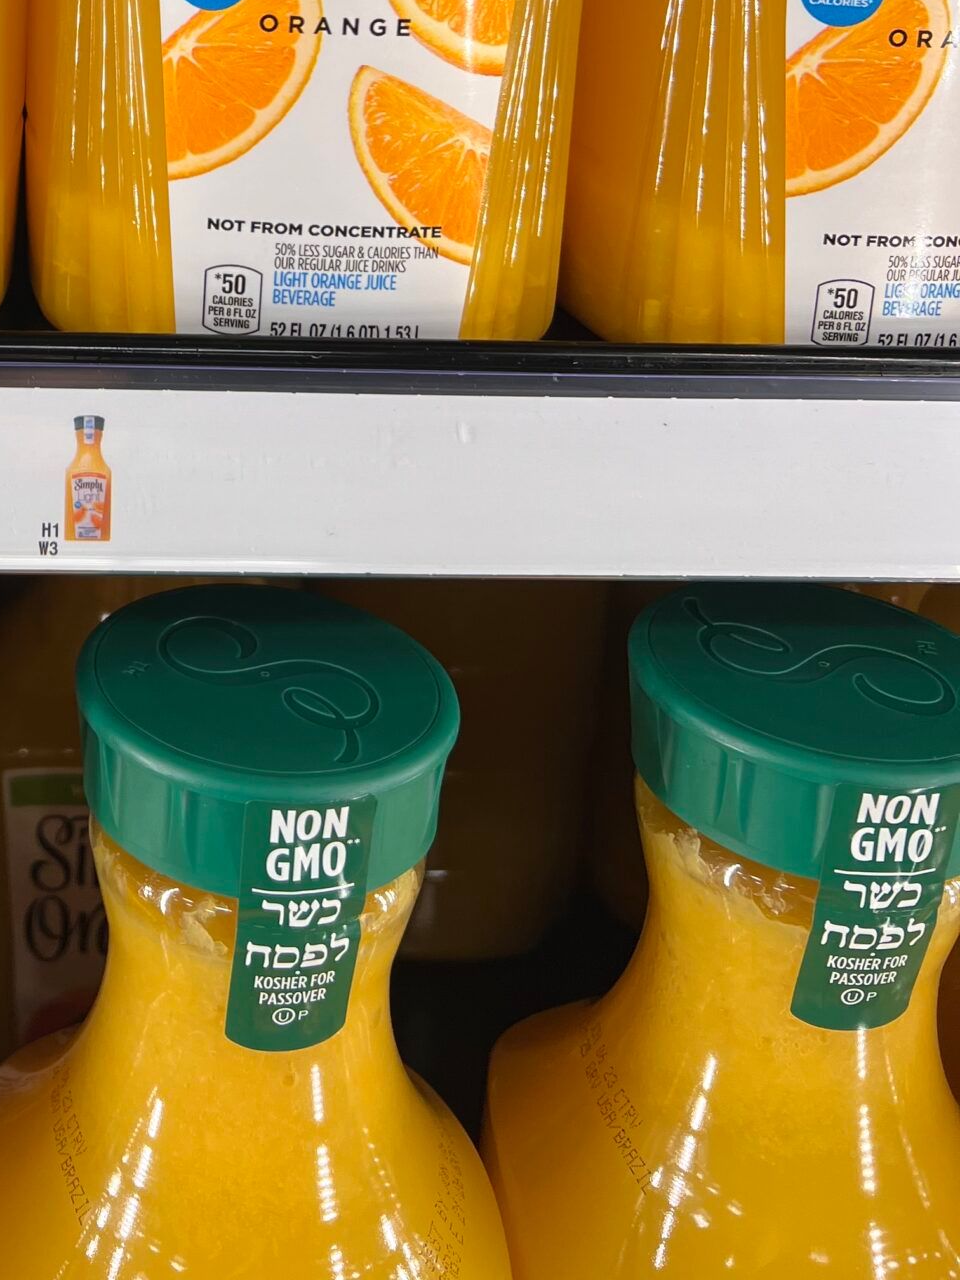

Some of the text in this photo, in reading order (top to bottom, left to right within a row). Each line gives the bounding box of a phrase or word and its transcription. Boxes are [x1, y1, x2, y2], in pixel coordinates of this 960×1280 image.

[258, 14, 412, 38] ORANGE
[207, 218, 442, 238] NOT FROM CONCENTRATE
[823, 234, 862, 247] NOT
[74, 478, 103, 493] Simply
[42, 523, 59, 538] H1
[38, 541, 58, 556] W3
[856, 793, 941, 825] NON
[269, 806, 350, 844] NON
[843, 880, 922, 910] כשר
[262, 898, 342, 928] כשר
[820, 918, 926, 950] לפסח
[245, 932, 350, 969] לפסח
[827, 954, 908, 970] KOSHER FOR
[254, 970, 335, 990] KOSHER FOR
[829, 971, 897, 986] PASSOVER
[259, 988, 327, 1005] PASSOVER
